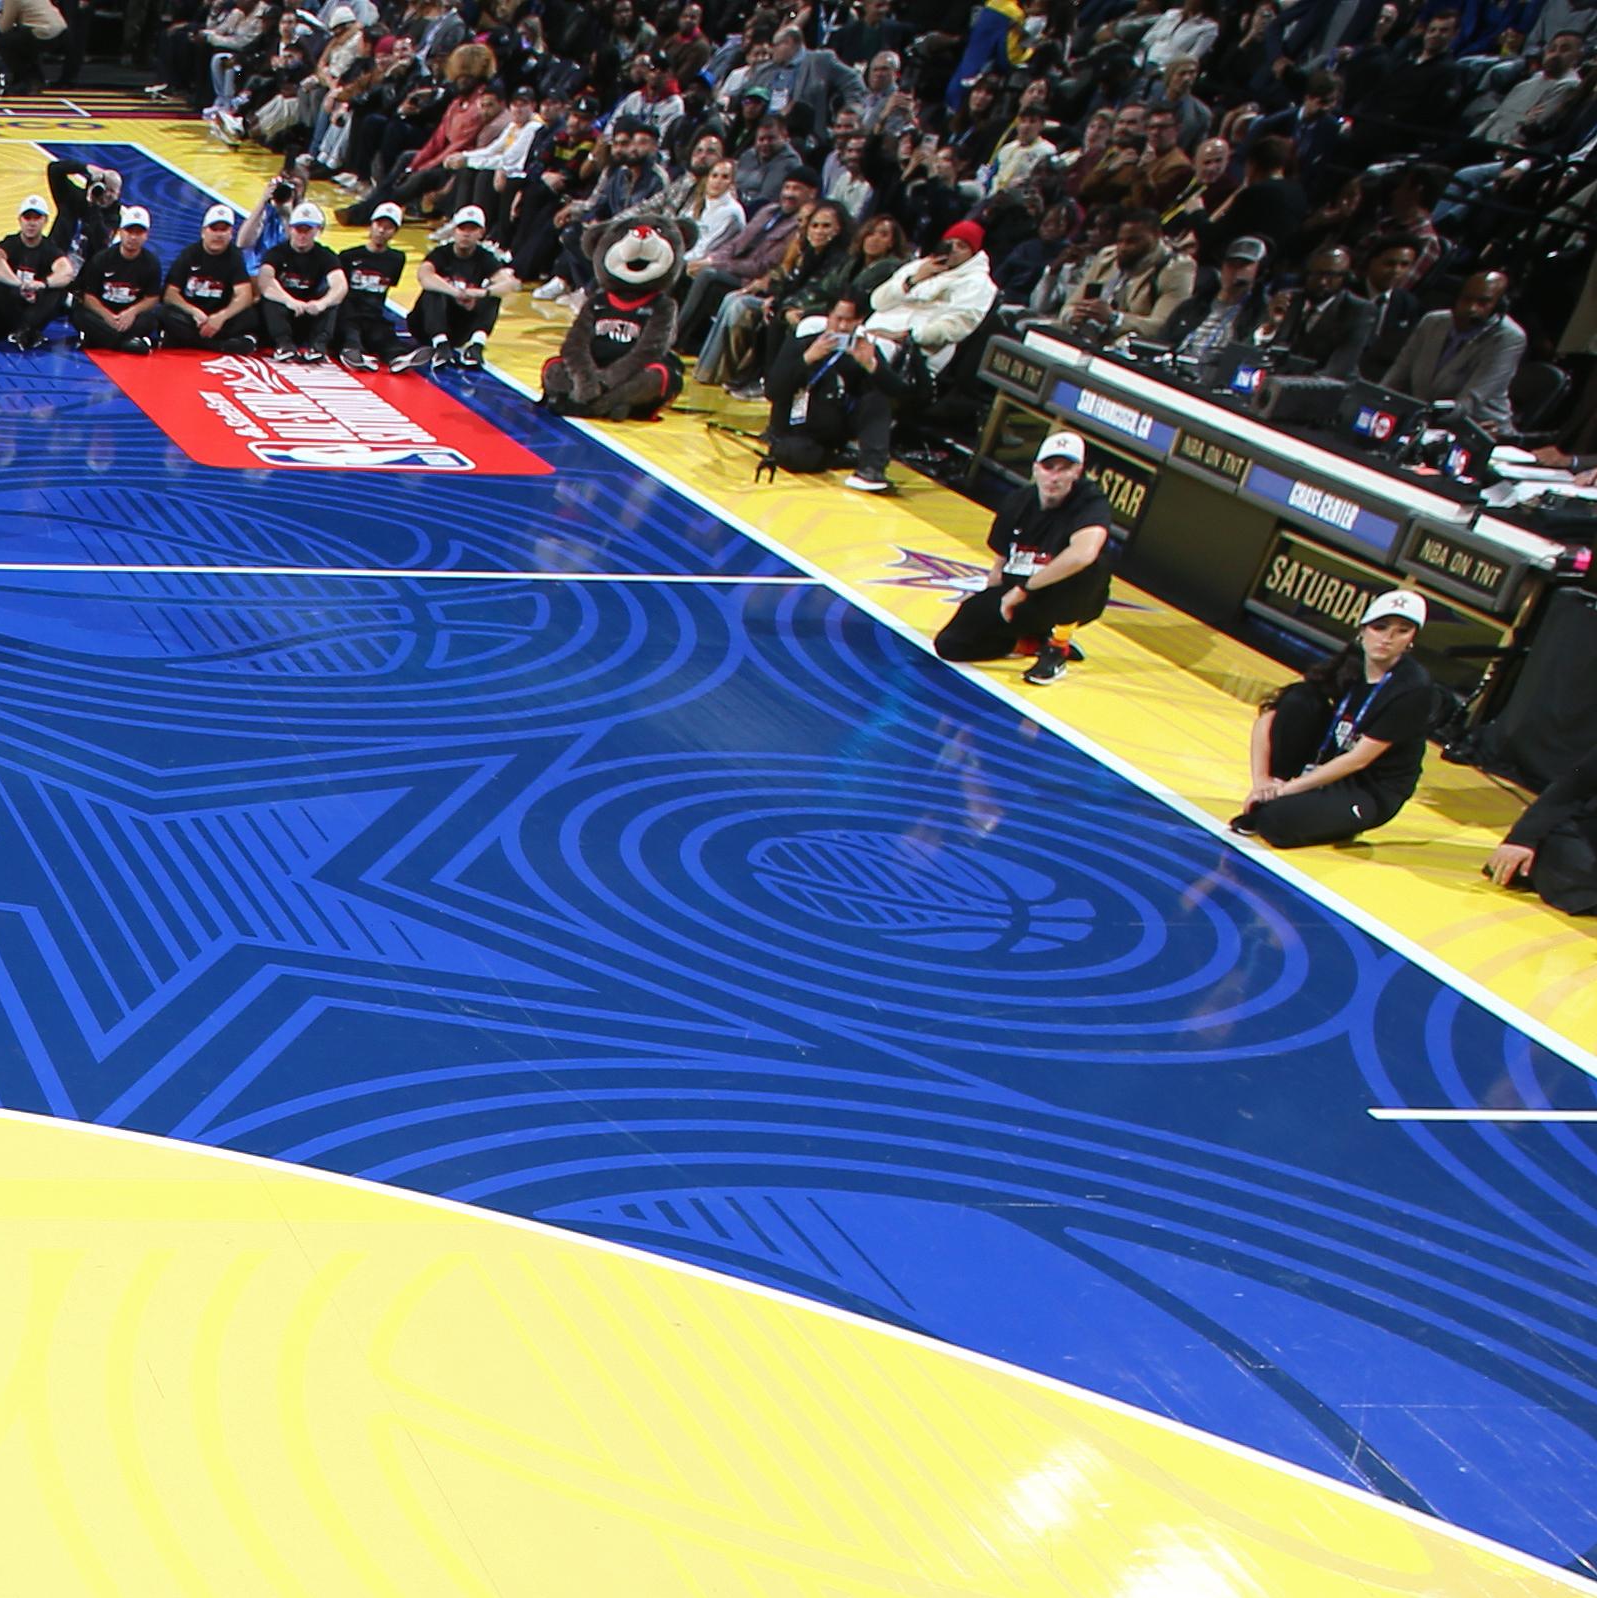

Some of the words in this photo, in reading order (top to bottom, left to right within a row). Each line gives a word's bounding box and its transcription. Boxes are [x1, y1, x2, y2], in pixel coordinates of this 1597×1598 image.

[1205, 445, 1224, 467] ON
[1222, 452, 1245, 476] TNT
[1101, 468, 1146, 518] STAR
[1419, 538, 1449, 568] NBA
[1449, 551, 1473, 576] ON
[1472, 560, 1502, 588] TNT
[1265, 554, 1378, 628] SATURDA
